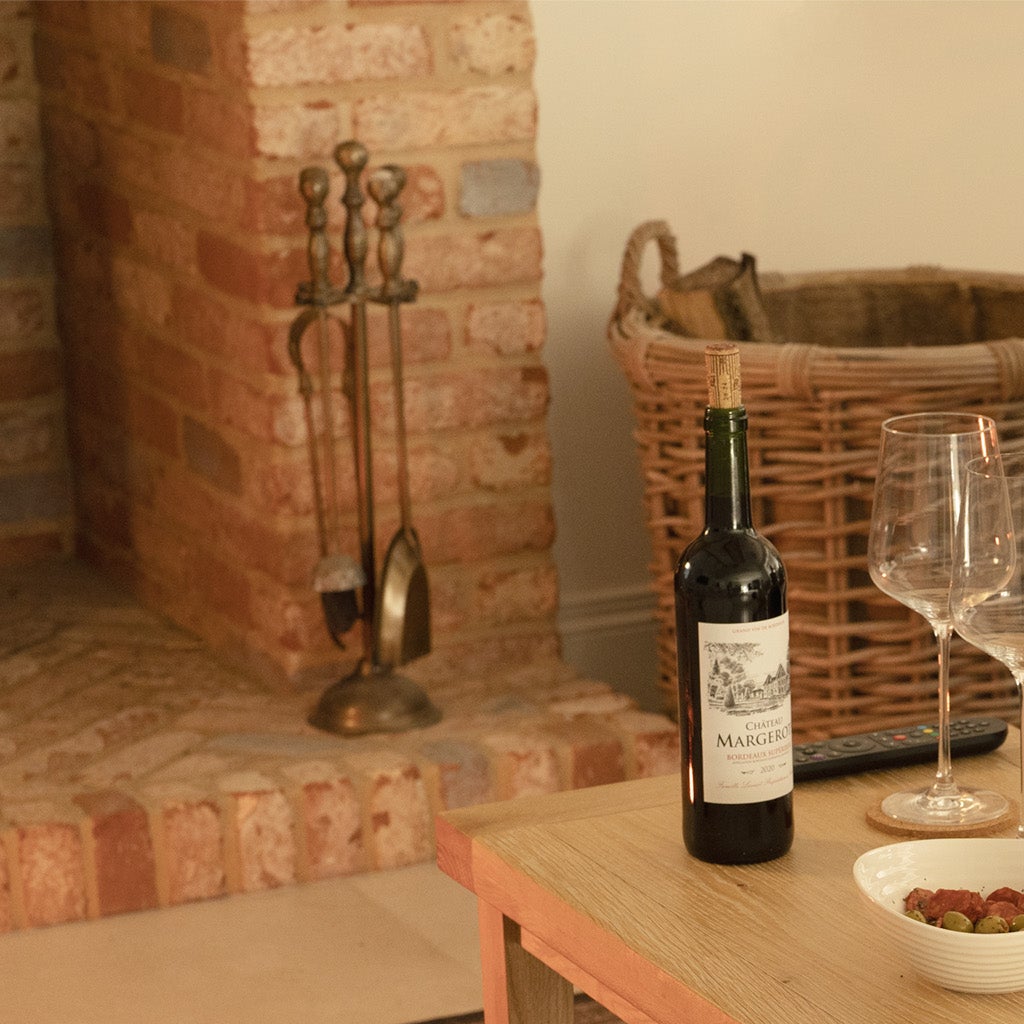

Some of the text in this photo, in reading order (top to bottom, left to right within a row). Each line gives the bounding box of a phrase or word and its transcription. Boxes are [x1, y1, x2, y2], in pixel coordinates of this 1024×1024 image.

[716, 723, 792, 748] MARGEROT
[726, 752, 767, 761] BORDEAUX
[760, 764, 776, 774] 2020
